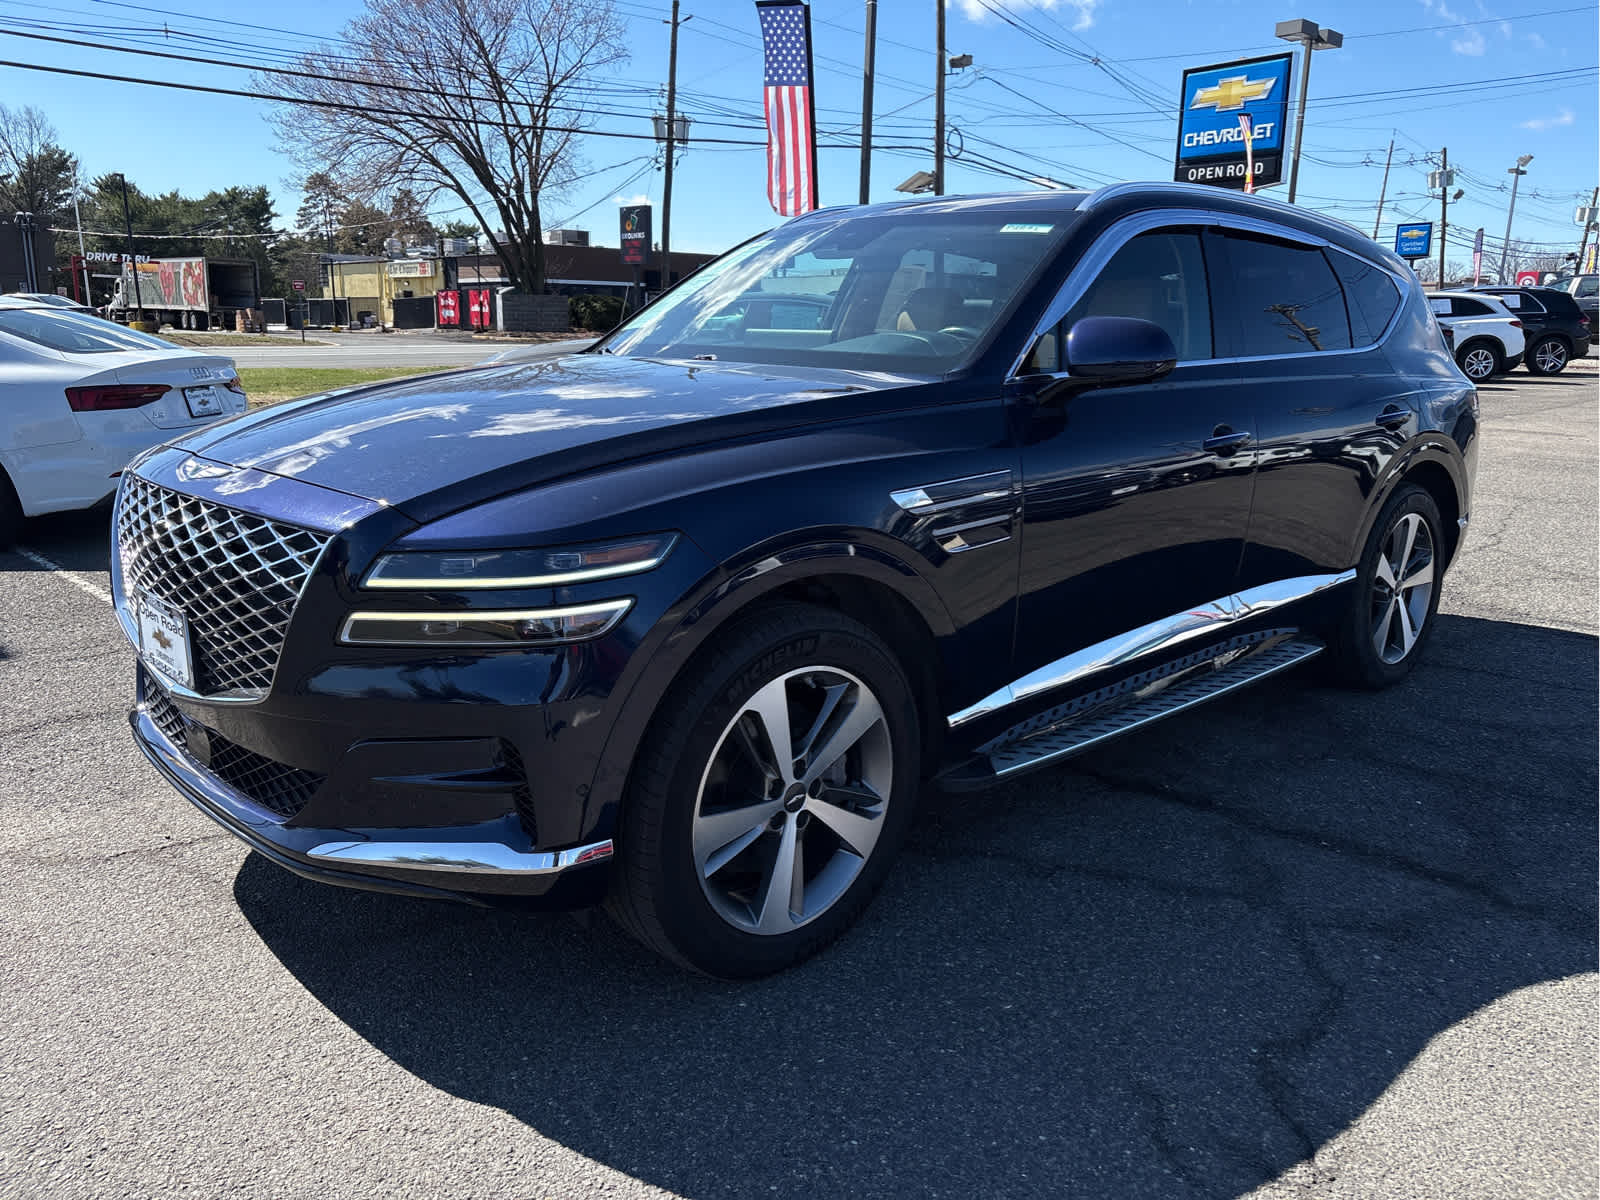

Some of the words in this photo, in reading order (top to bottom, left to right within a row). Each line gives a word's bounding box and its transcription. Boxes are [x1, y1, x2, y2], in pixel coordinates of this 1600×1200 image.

[1188, 166, 1223, 181] OPEN
[1226, 162, 1264, 177] ROD
[86, 252, 118, 262] DRIVE
[140, 602, 159, 623] Open
[160, 615, 185, 637] Road
[728, 639, 819, 703] MICHELIN
